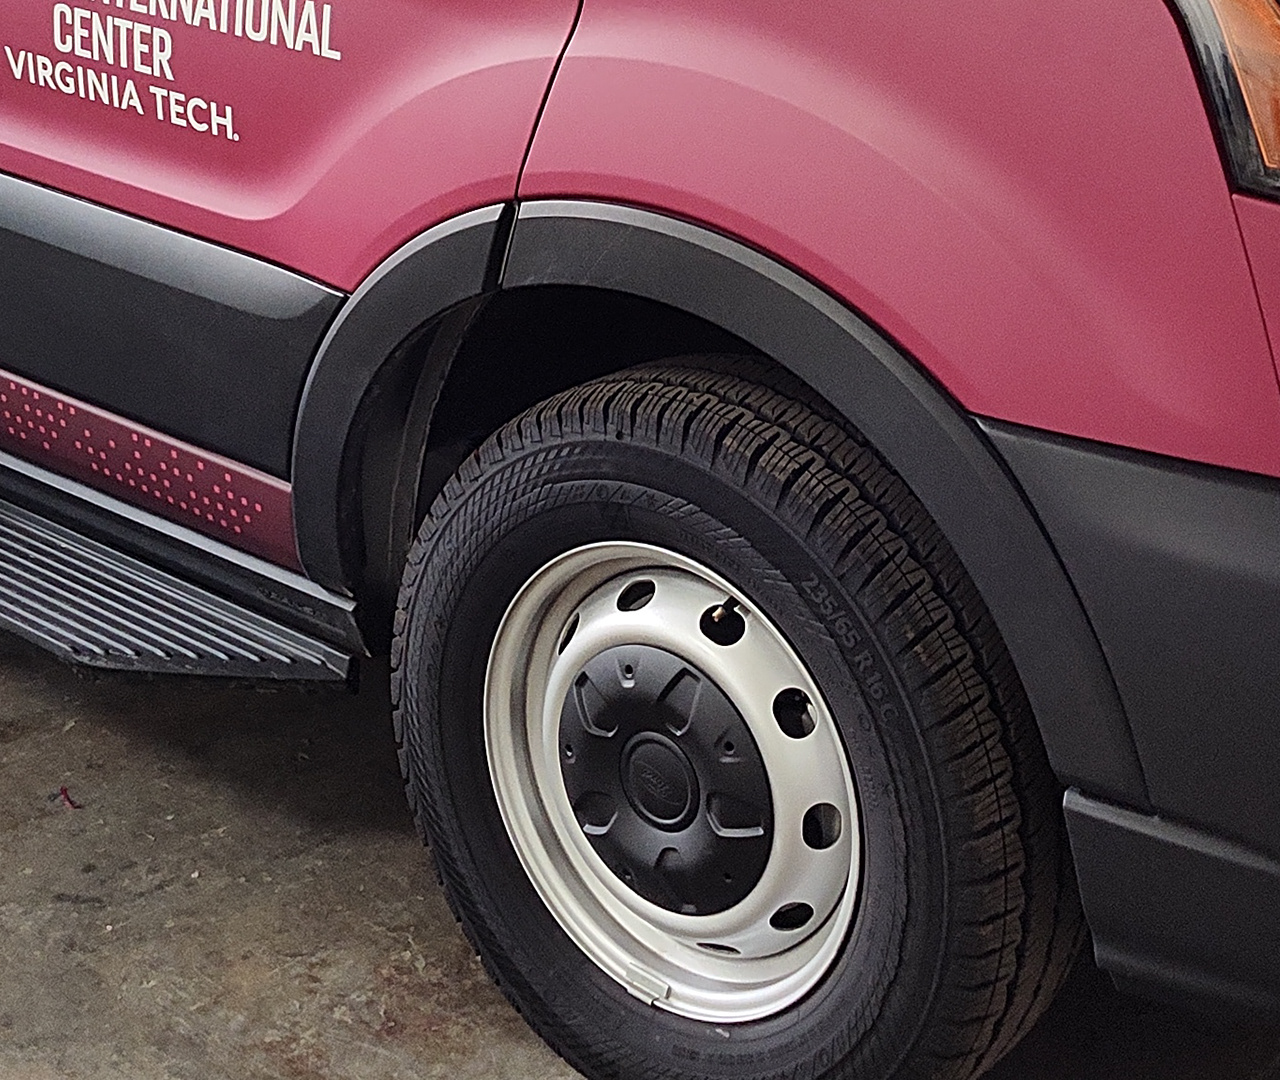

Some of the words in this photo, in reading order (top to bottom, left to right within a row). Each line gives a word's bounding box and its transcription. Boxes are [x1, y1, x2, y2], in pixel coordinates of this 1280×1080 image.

[52, 3, 175, 81] CENTER
[4, 45, 144, 115] VIRGINIA
[149, 85, 241, 143] TECH.
[801, 572, 862, 649] 235/65
[854, 648, 874, 672] R
[867, 672, 884, 701] 16
